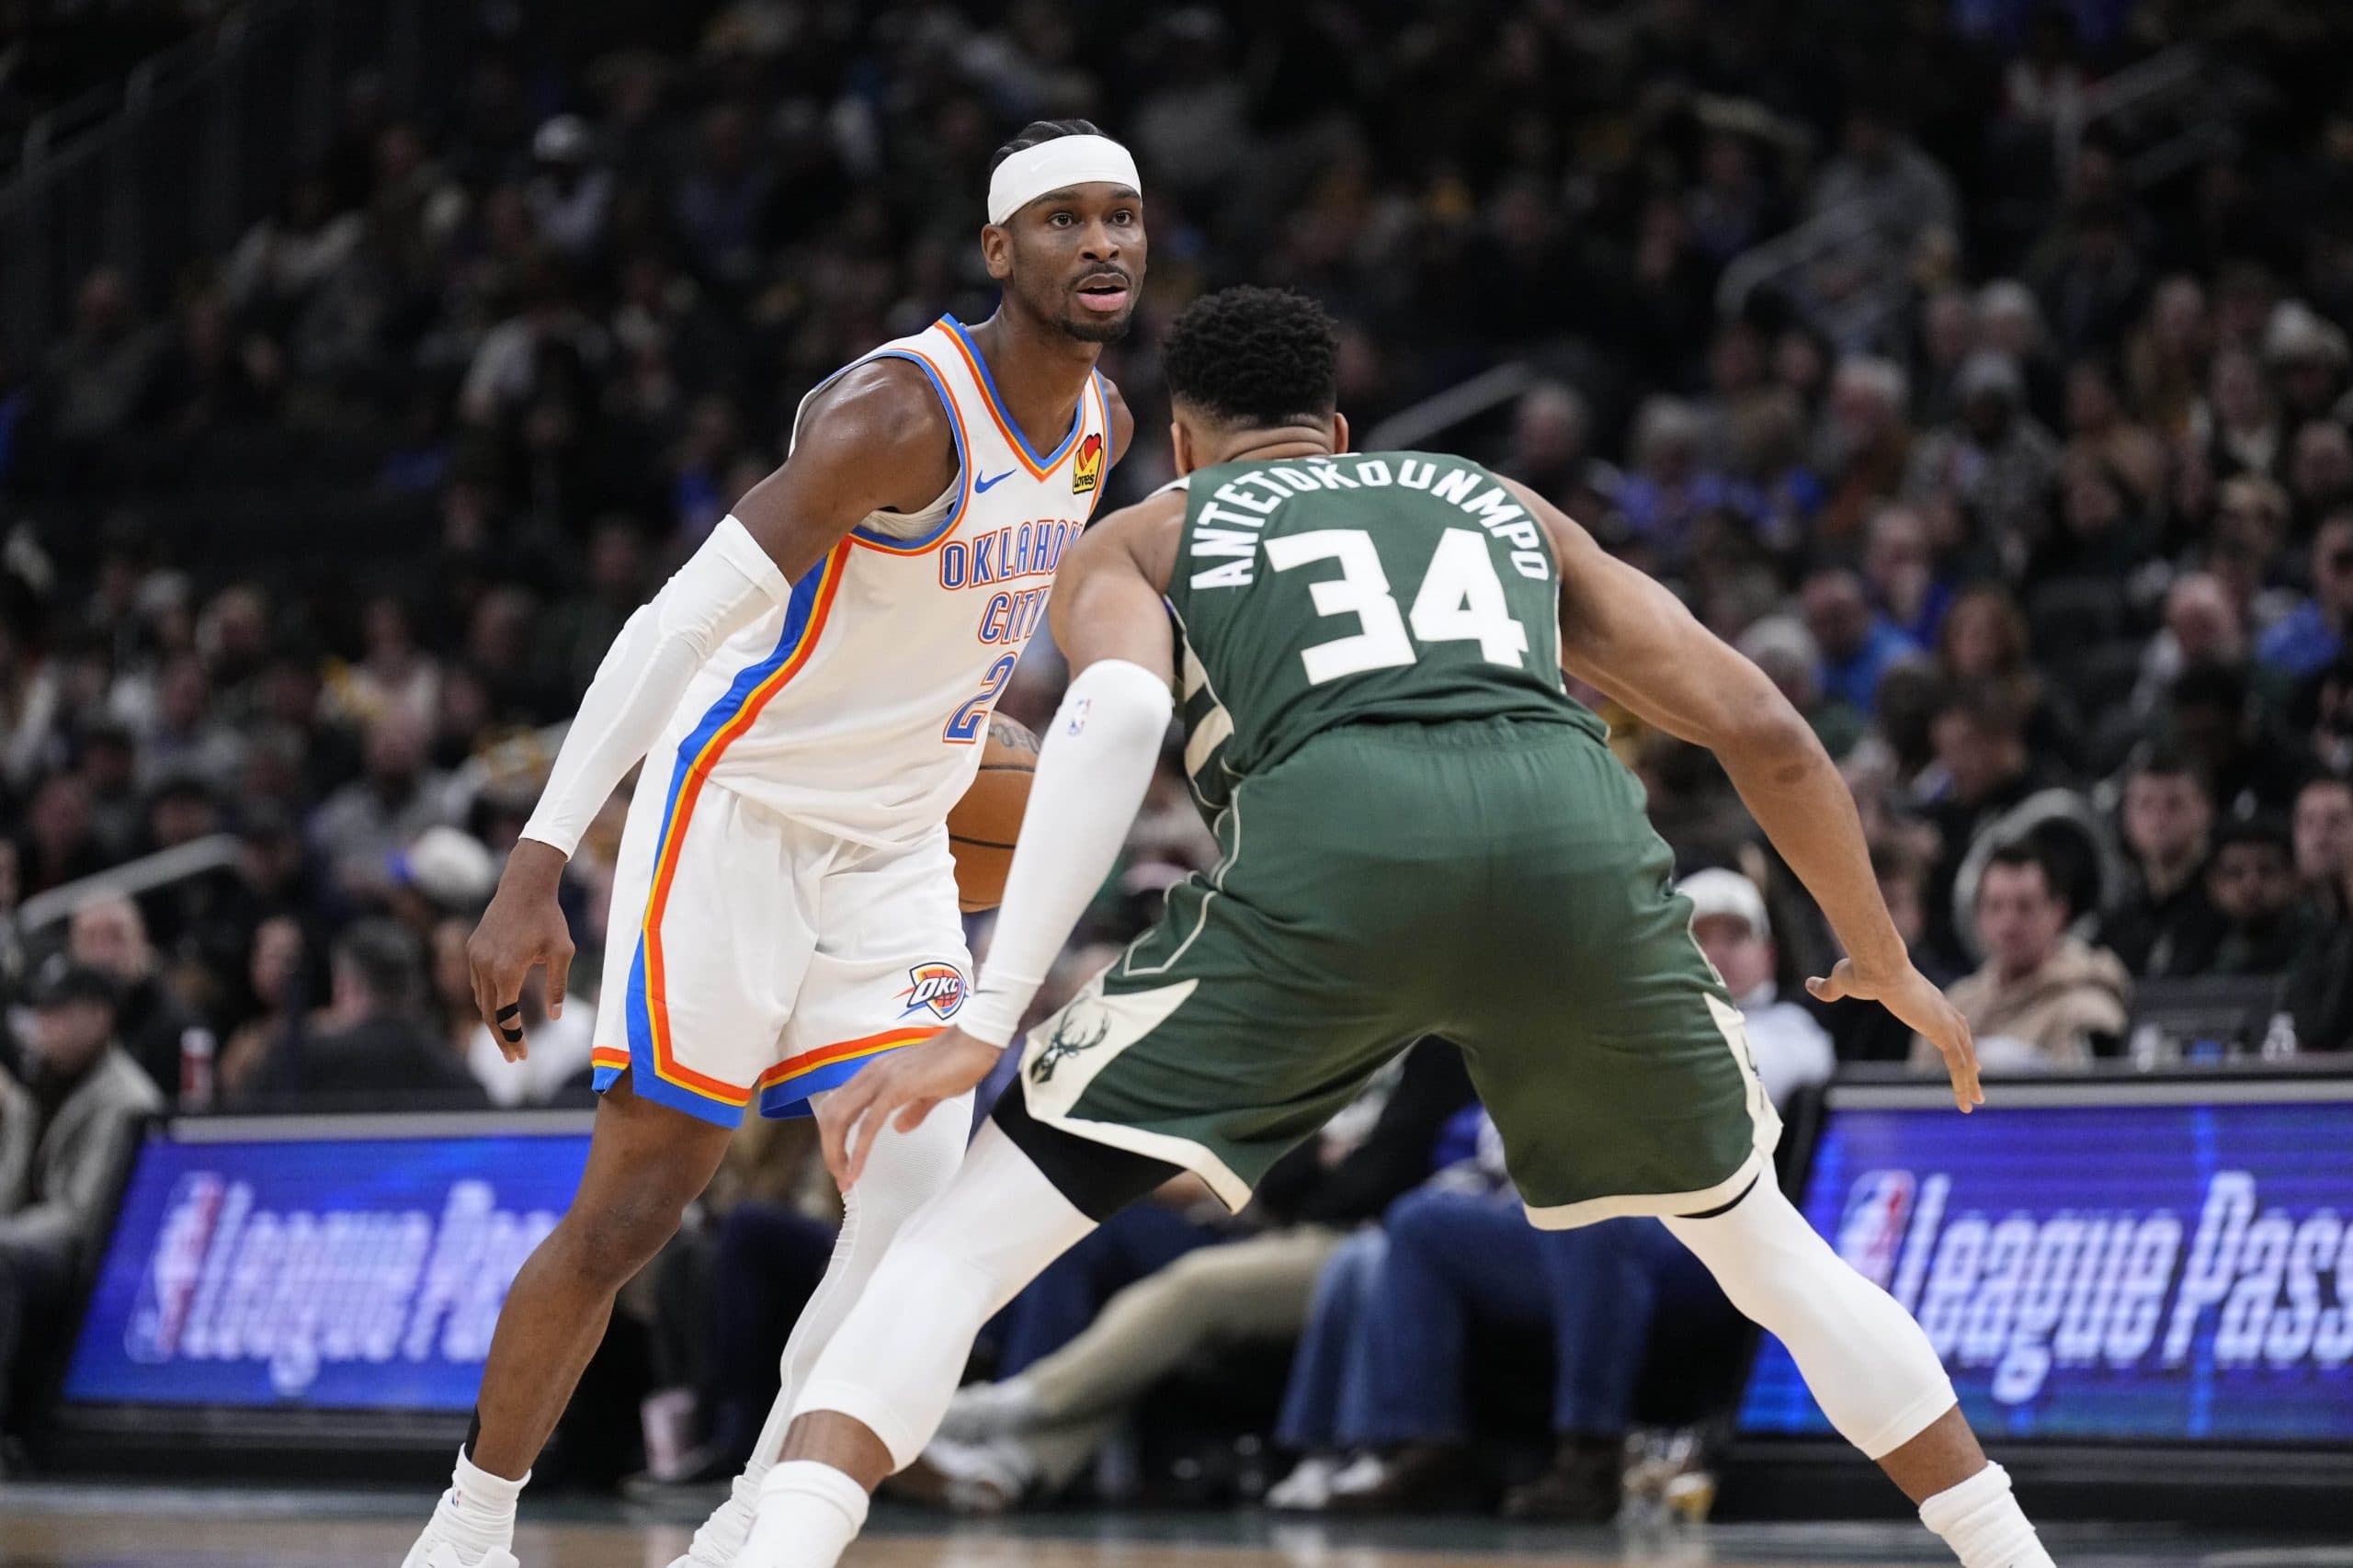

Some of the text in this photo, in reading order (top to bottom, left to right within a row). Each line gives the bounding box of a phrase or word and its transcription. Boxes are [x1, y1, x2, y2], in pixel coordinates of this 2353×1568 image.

[1190, 459, 1550, 590] ANTETOKOUNMPO
[977, 585, 1051, 644] CITY
[1263, 527, 1530, 687] 34
[942, 651, 1018, 744] 2
[908, 976, 960, 1006] OKC
